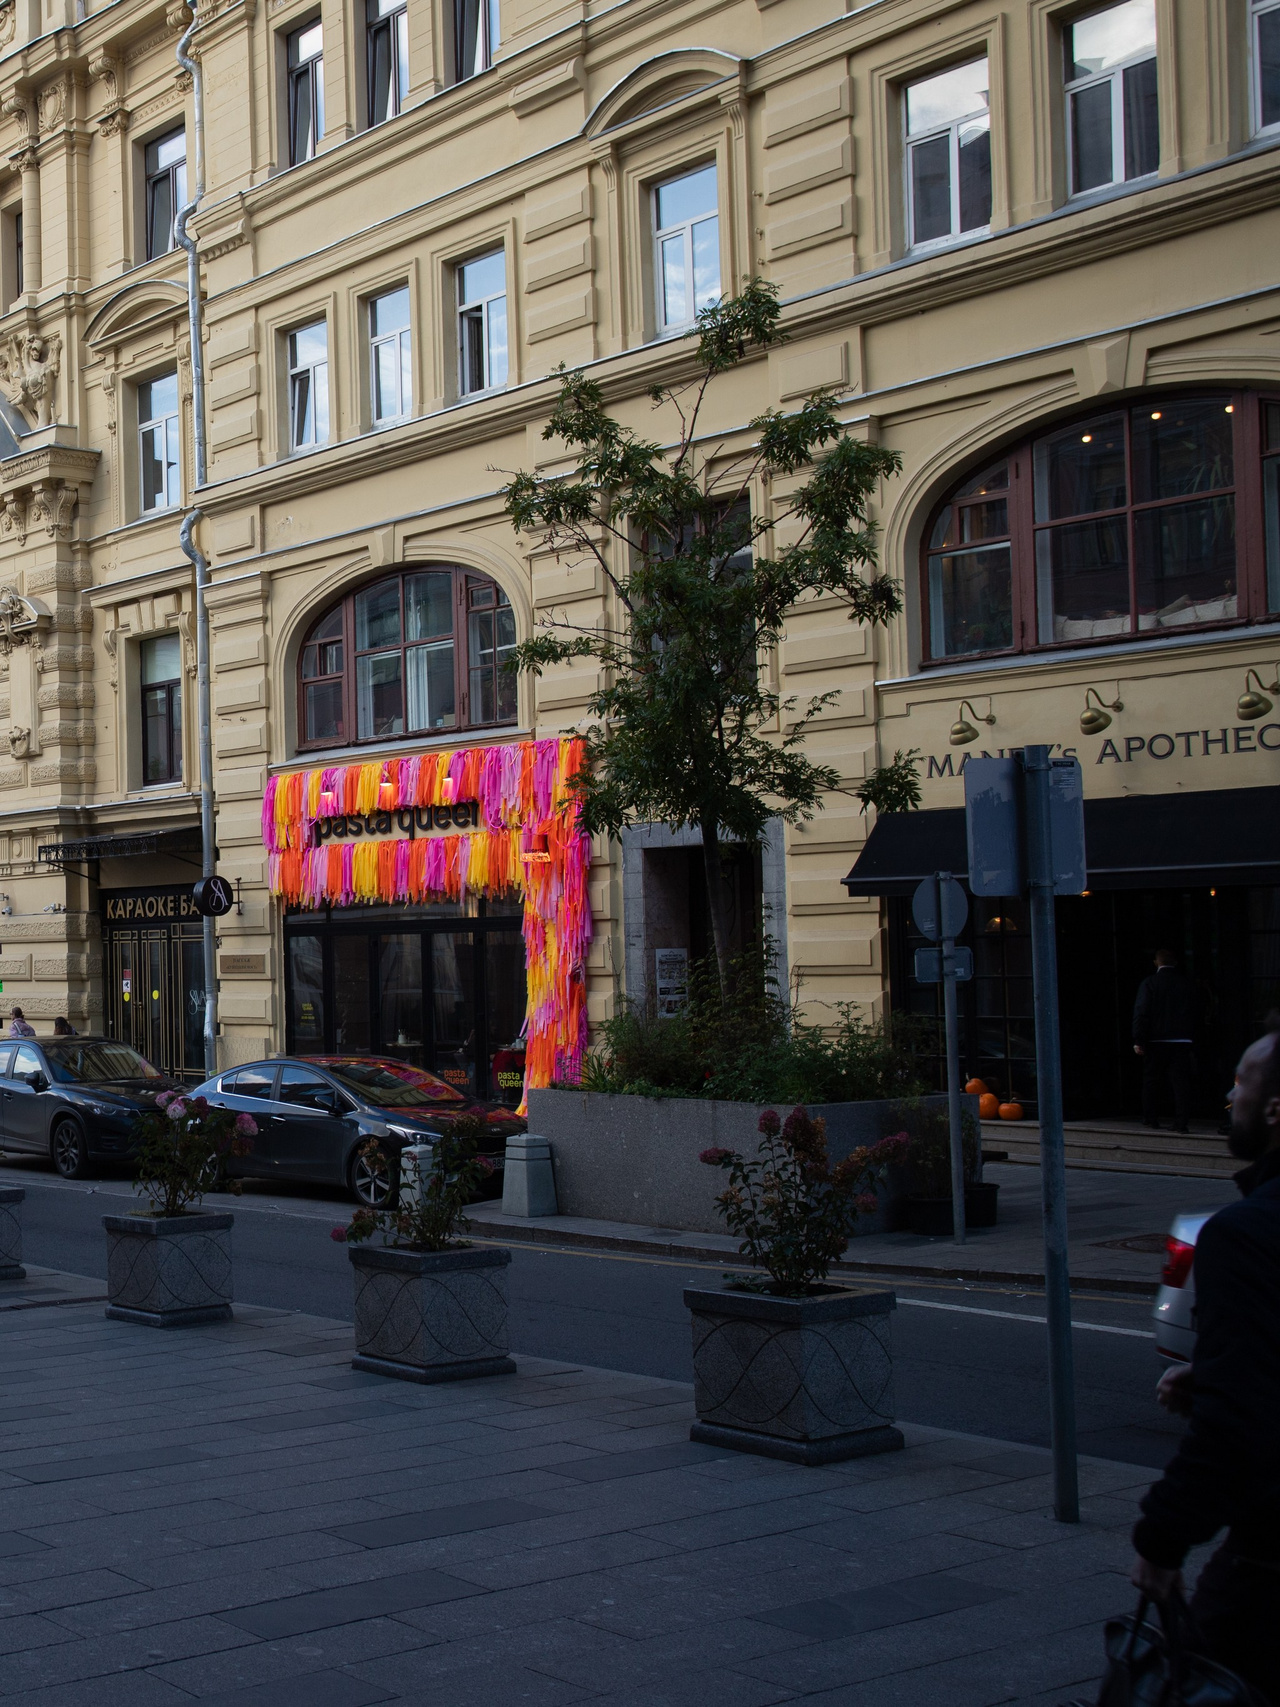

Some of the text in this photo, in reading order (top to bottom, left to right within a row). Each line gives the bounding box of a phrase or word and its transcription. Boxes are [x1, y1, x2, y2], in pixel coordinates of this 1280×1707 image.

[926, 743, 1078, 779] MA'S
[315, 809, 393, 847] pasta
[106, 894, 201, 919] КАРАОКЕ БА
[443, 1069, 466, 1079] pasta
[497, 1071, 521, 1082] pasta
[499, 1079, 524, 1089] queen
